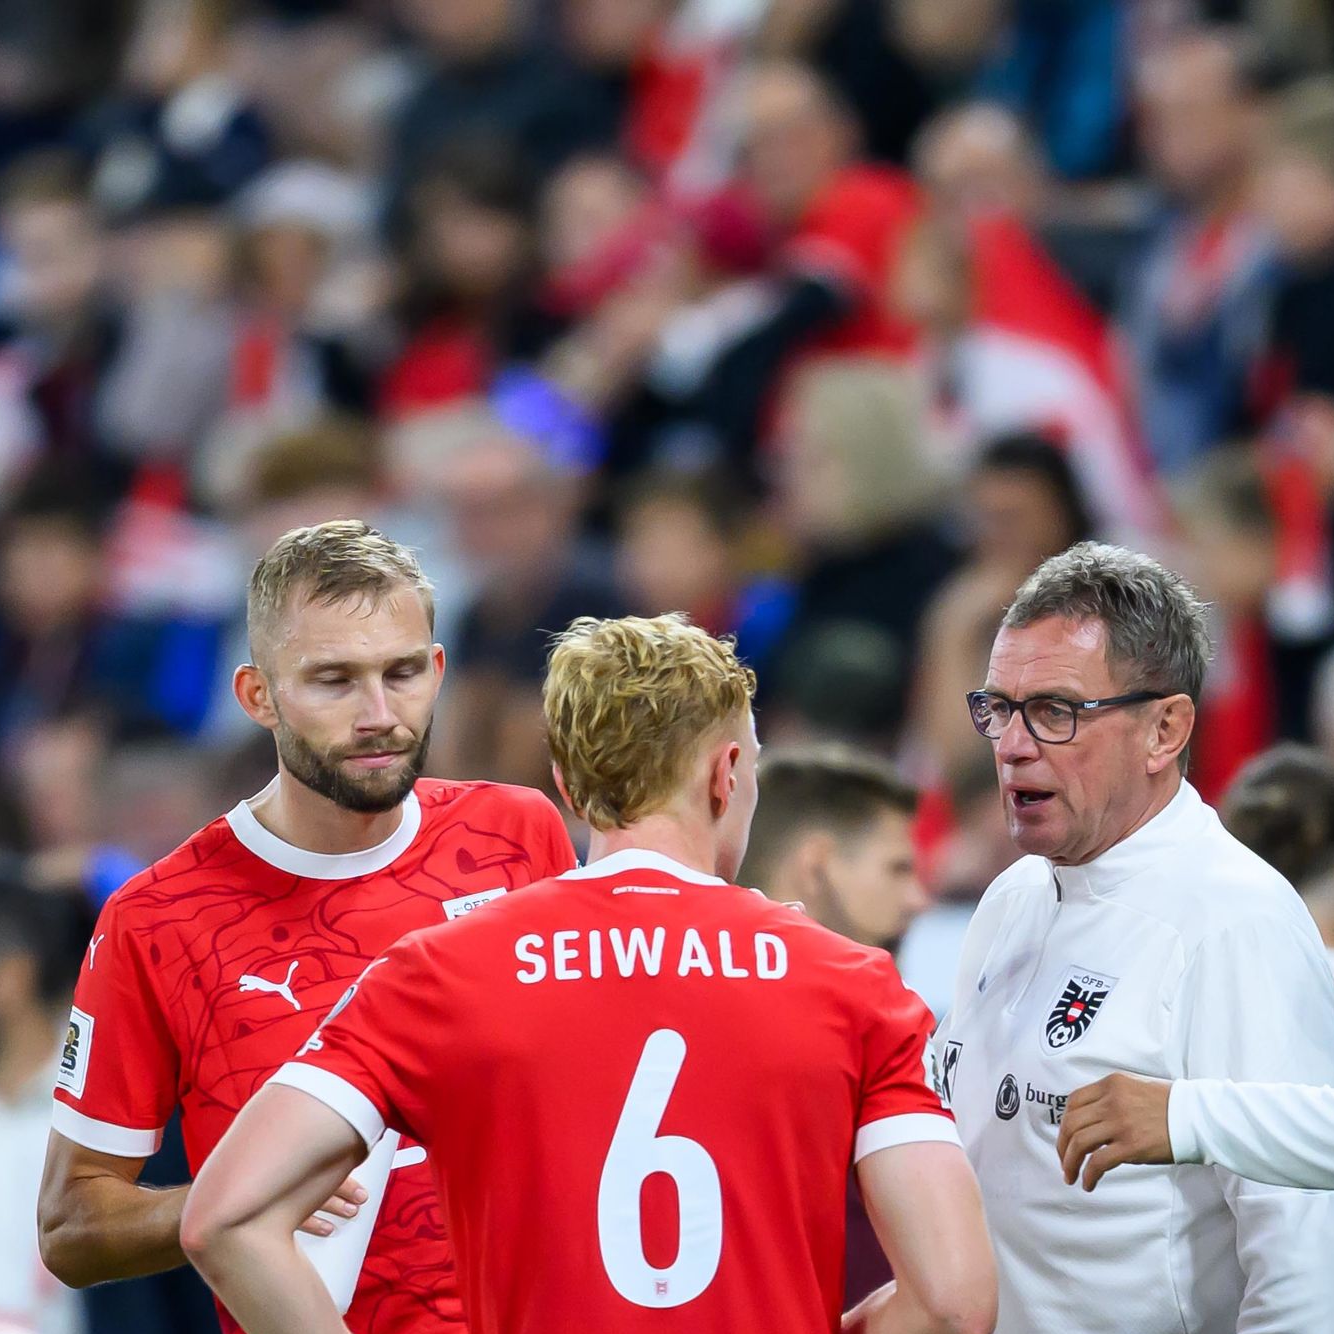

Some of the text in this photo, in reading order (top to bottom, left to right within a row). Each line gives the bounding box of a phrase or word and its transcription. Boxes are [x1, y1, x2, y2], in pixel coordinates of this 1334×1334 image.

[514, 926, 789, 985] SEIWALD
[1026, 1082, 1068, 1111] burg
[597, 1028, 723, 1308] 6
